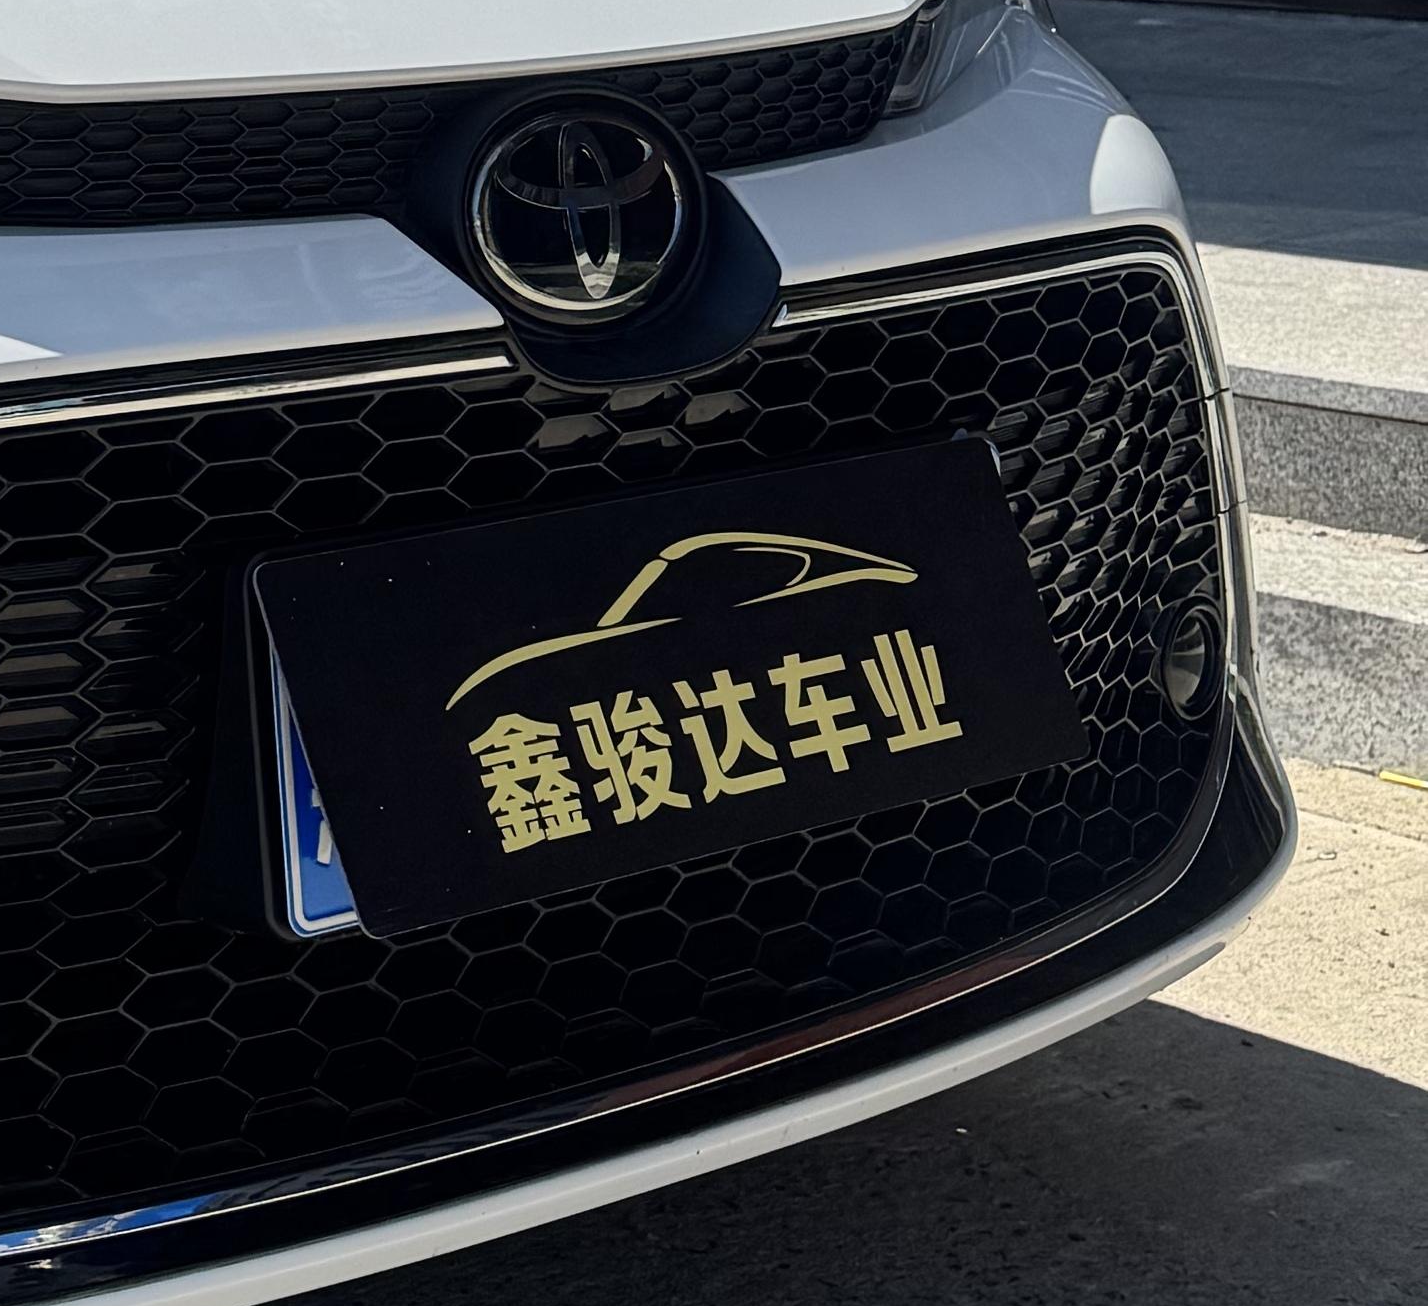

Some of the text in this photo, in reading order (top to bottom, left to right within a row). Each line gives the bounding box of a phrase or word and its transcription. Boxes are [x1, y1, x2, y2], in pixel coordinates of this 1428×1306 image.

[468, 629, 964, 854] 鑫骏达车业
